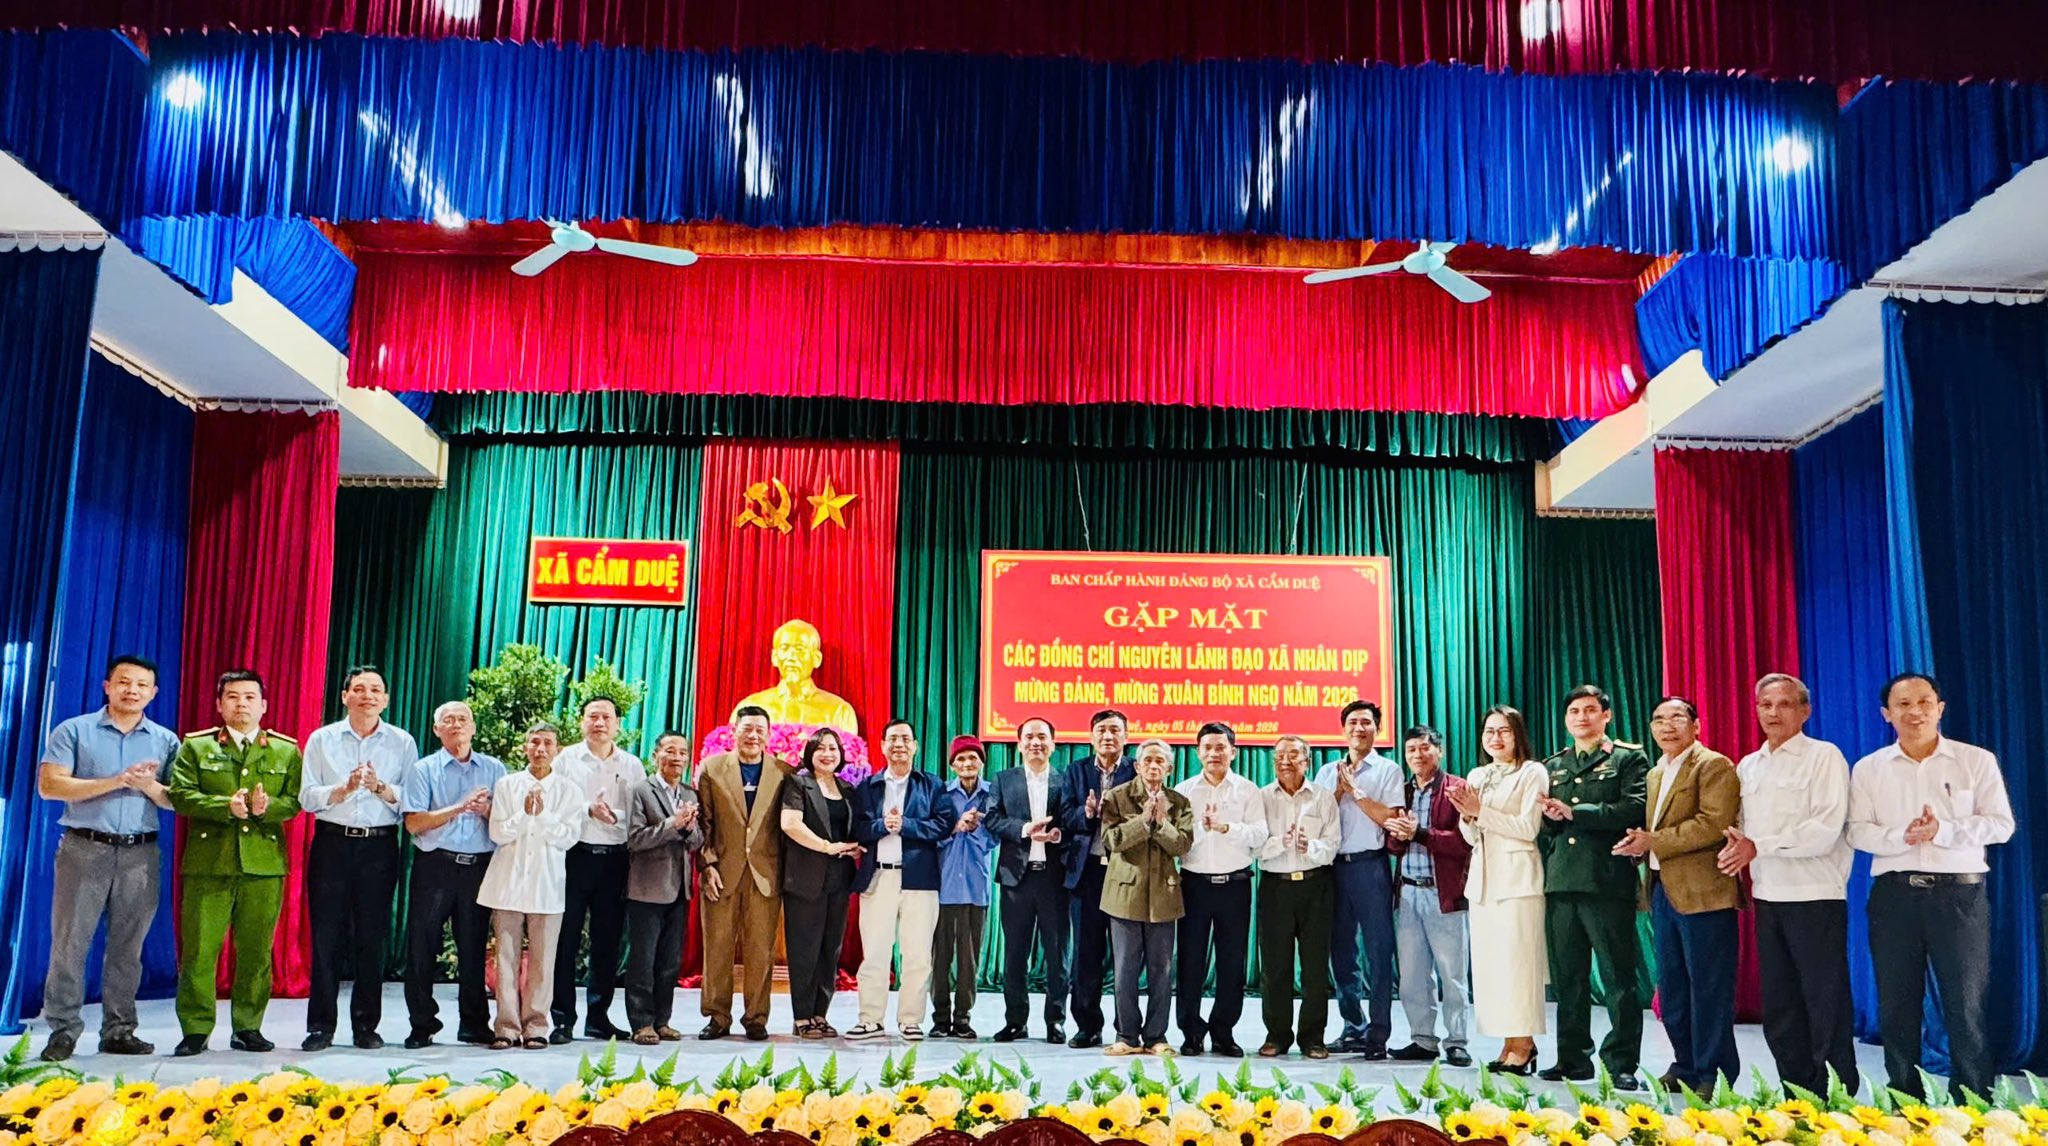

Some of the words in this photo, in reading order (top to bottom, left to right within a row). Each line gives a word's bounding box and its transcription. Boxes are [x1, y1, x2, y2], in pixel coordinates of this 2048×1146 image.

[537, 552, 570, 584] XÃ
[576, 546, 629, 586] CẨM
[634, 554, 679, 593] DUỆ
[1051, 573, 1080, 586] BAN
[1083, 570, 1122, 587] CHẤP
[1126, 571, 1165, 587] HÀNH
[1169, 572, 1208, 588] ĐẢNG
[1212, 573, 1232, 591] BỘ
[1236, 574, 1254, 588] XÃ
[1293, 575, 1320, 592] DUỆ
[1104, 600, 1180, 633] GẶP
[1188, 602, 1268, 634] MẶT
[1003, 639, 1035, 667] CÁC
[1039, 636, 1083, 668] ĐỒNG
[1088, 640, 1114, 668] CHÍ
[1119, 641, 1182, 669] NGUYÊN
[1186, 642, 1228, 670] LÃNH
[1232, 646, 1264, 676] ĐẠO
[1268, 643, 1290, 671] XÃ
[1294, 643, 1338, 671] NHÂN
[1342, 648, 1369, 677] DỊP
[1014, 676, 1060, 703] MỪNG
[1063, 674, 1110, 706] ĐẢNG,
[1113, 678, 1159, 705] MỪNG
[1162, 678, 1204, 705] XUÂN
[1208, 679, 1244, 706] BÍNH
[1248, 684, 1279, 711] NGỌ
[1283, 680, 1318, 707] NĂM
[1322, 685, 1358, 707] 2026
[1127, 719, 1142, 733] uệ,
[1172, 719, 1185, 731] 05
[1256, 720, 1279, 733] 2026
